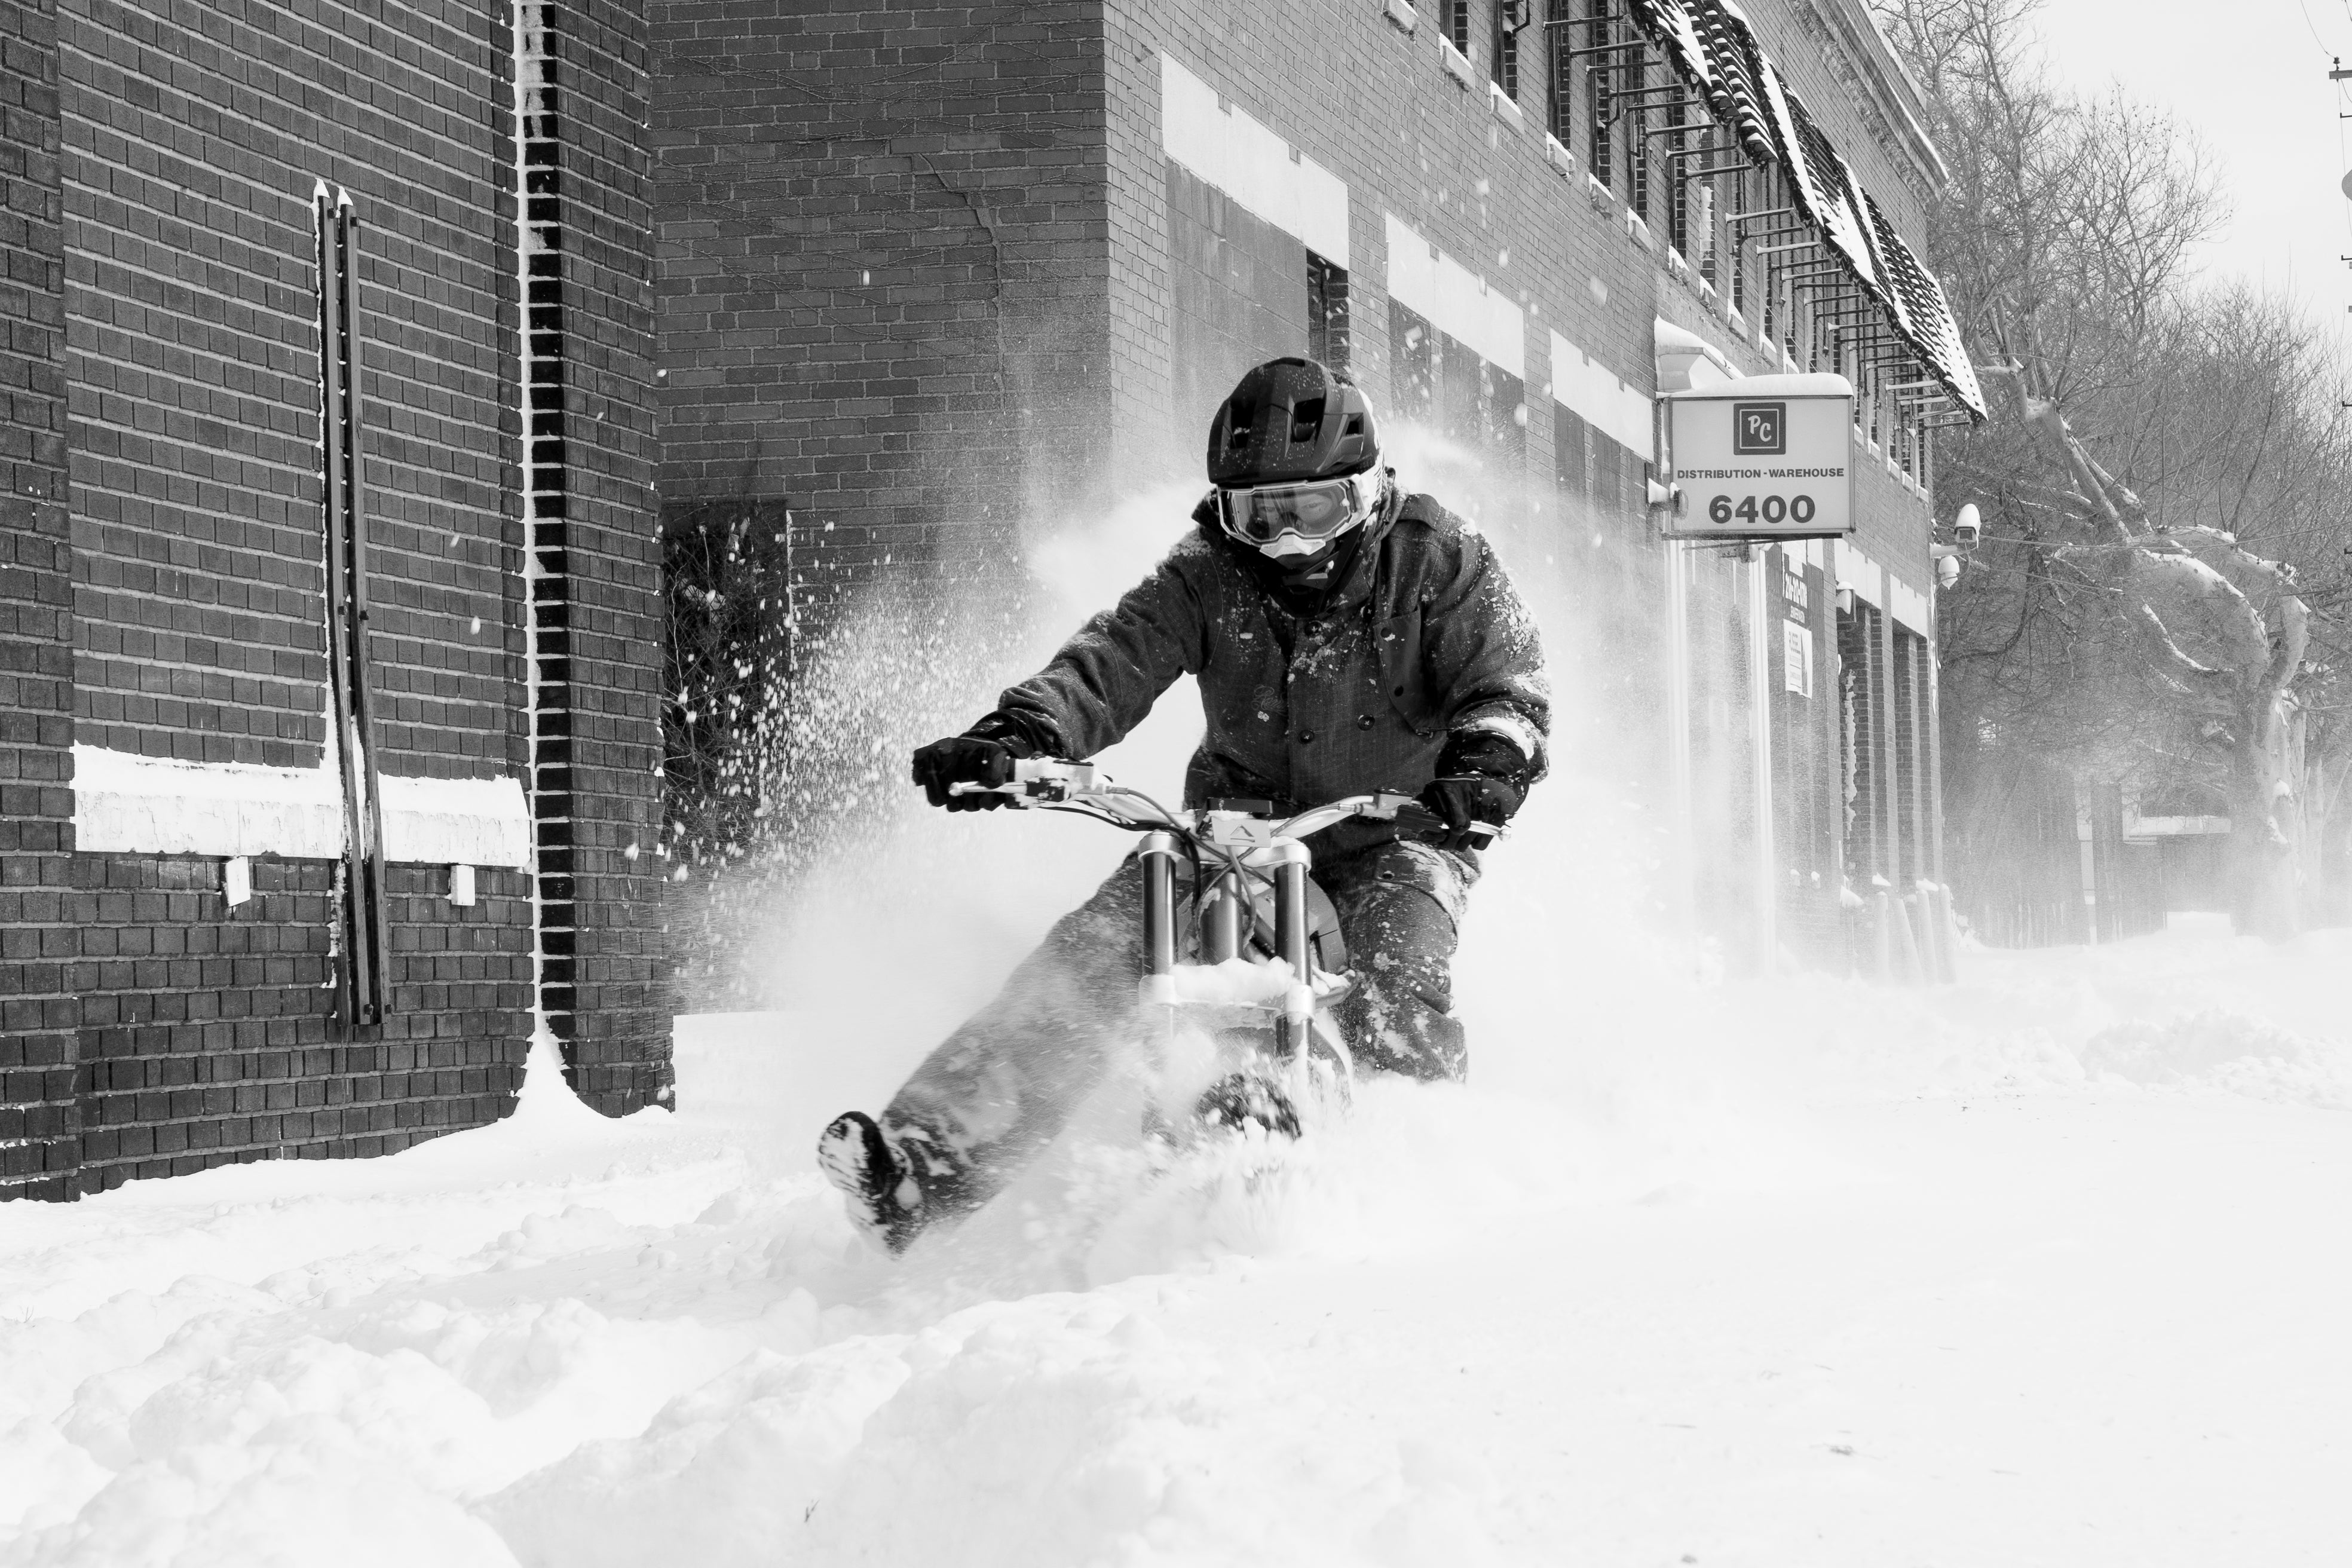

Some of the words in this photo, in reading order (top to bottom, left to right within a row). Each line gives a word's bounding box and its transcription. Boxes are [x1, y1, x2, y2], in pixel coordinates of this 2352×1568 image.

[1747, 415, 1772, 442] PC
[1677, 469, 1761, 479] DISTRIBUTION
[1768, 468, 1844, 478] WAREHOUSE
[1708, 495, 1816, 524] 6400
